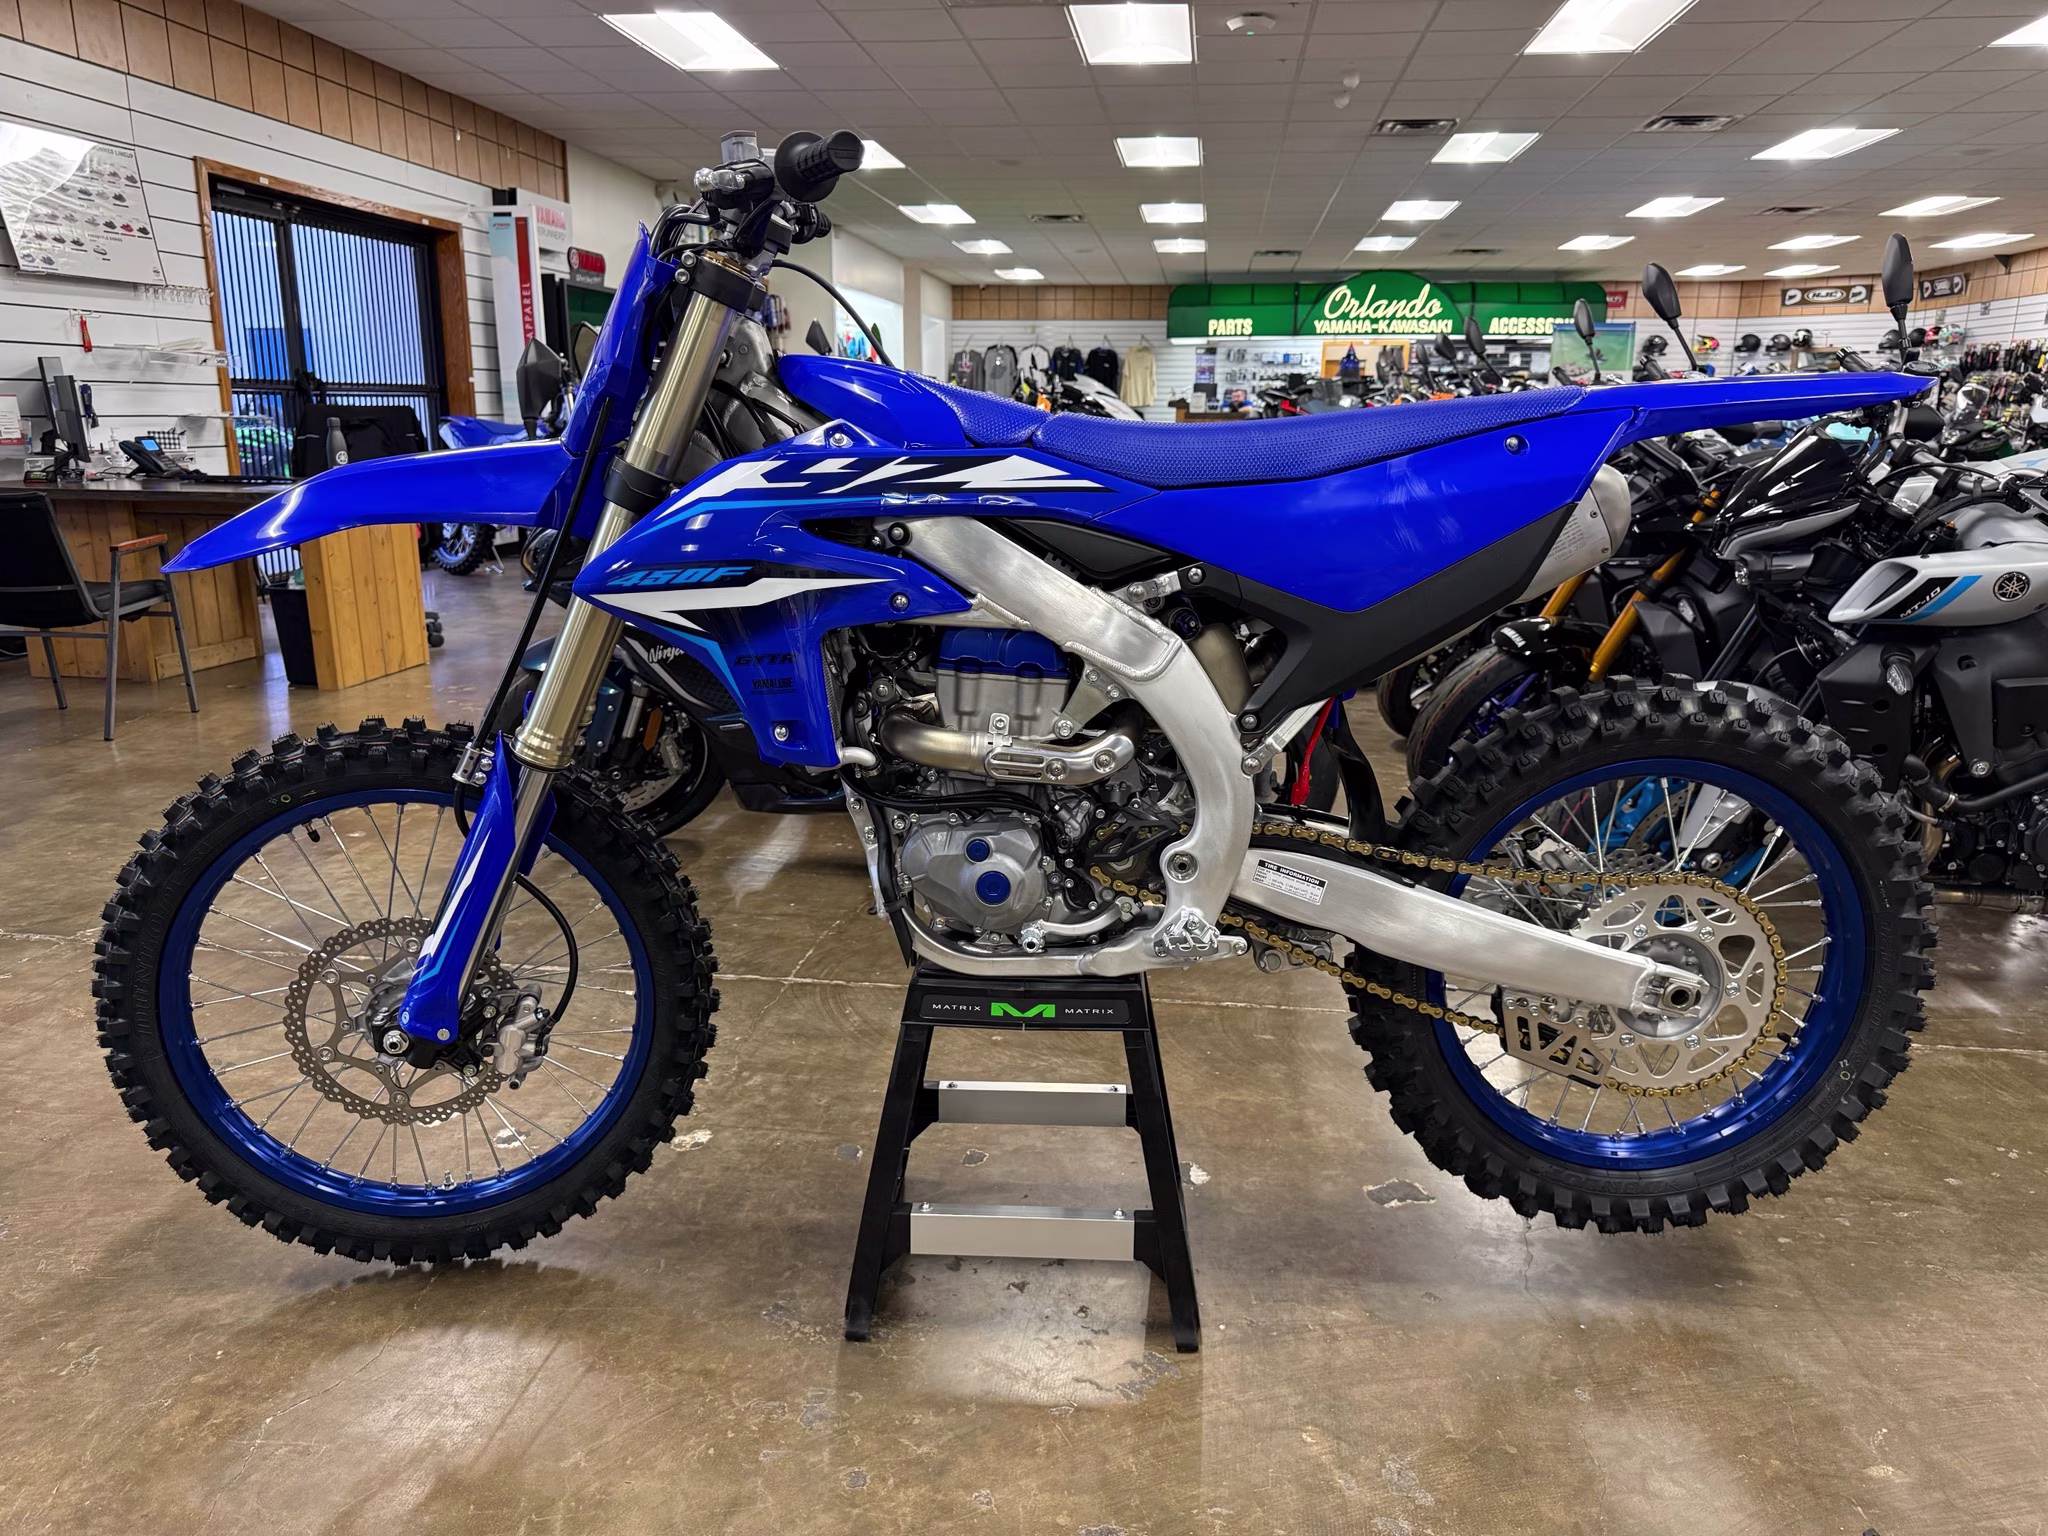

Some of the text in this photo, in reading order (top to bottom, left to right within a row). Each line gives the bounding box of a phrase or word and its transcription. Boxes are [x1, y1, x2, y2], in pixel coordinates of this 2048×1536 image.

[522, 282, 535, 341] APPAREL
[1323, 282, 1443, 320] Orlando
[1207, 318, 1253, 337] PARTS
[1313, 319, 1453, 334] YAMAHA-KAWASAKI
[607, 566, 753, 587] 450F
[1899, 586, 1942, 618] MT-10
[734, 654, 796, 667] GYTR
[1264, 862, 1320, 886] TIRE INFORMATION
[932, 1003, 982, 1012] MATRIX
[1065, 1007, 1114, 1015] MATRIX
